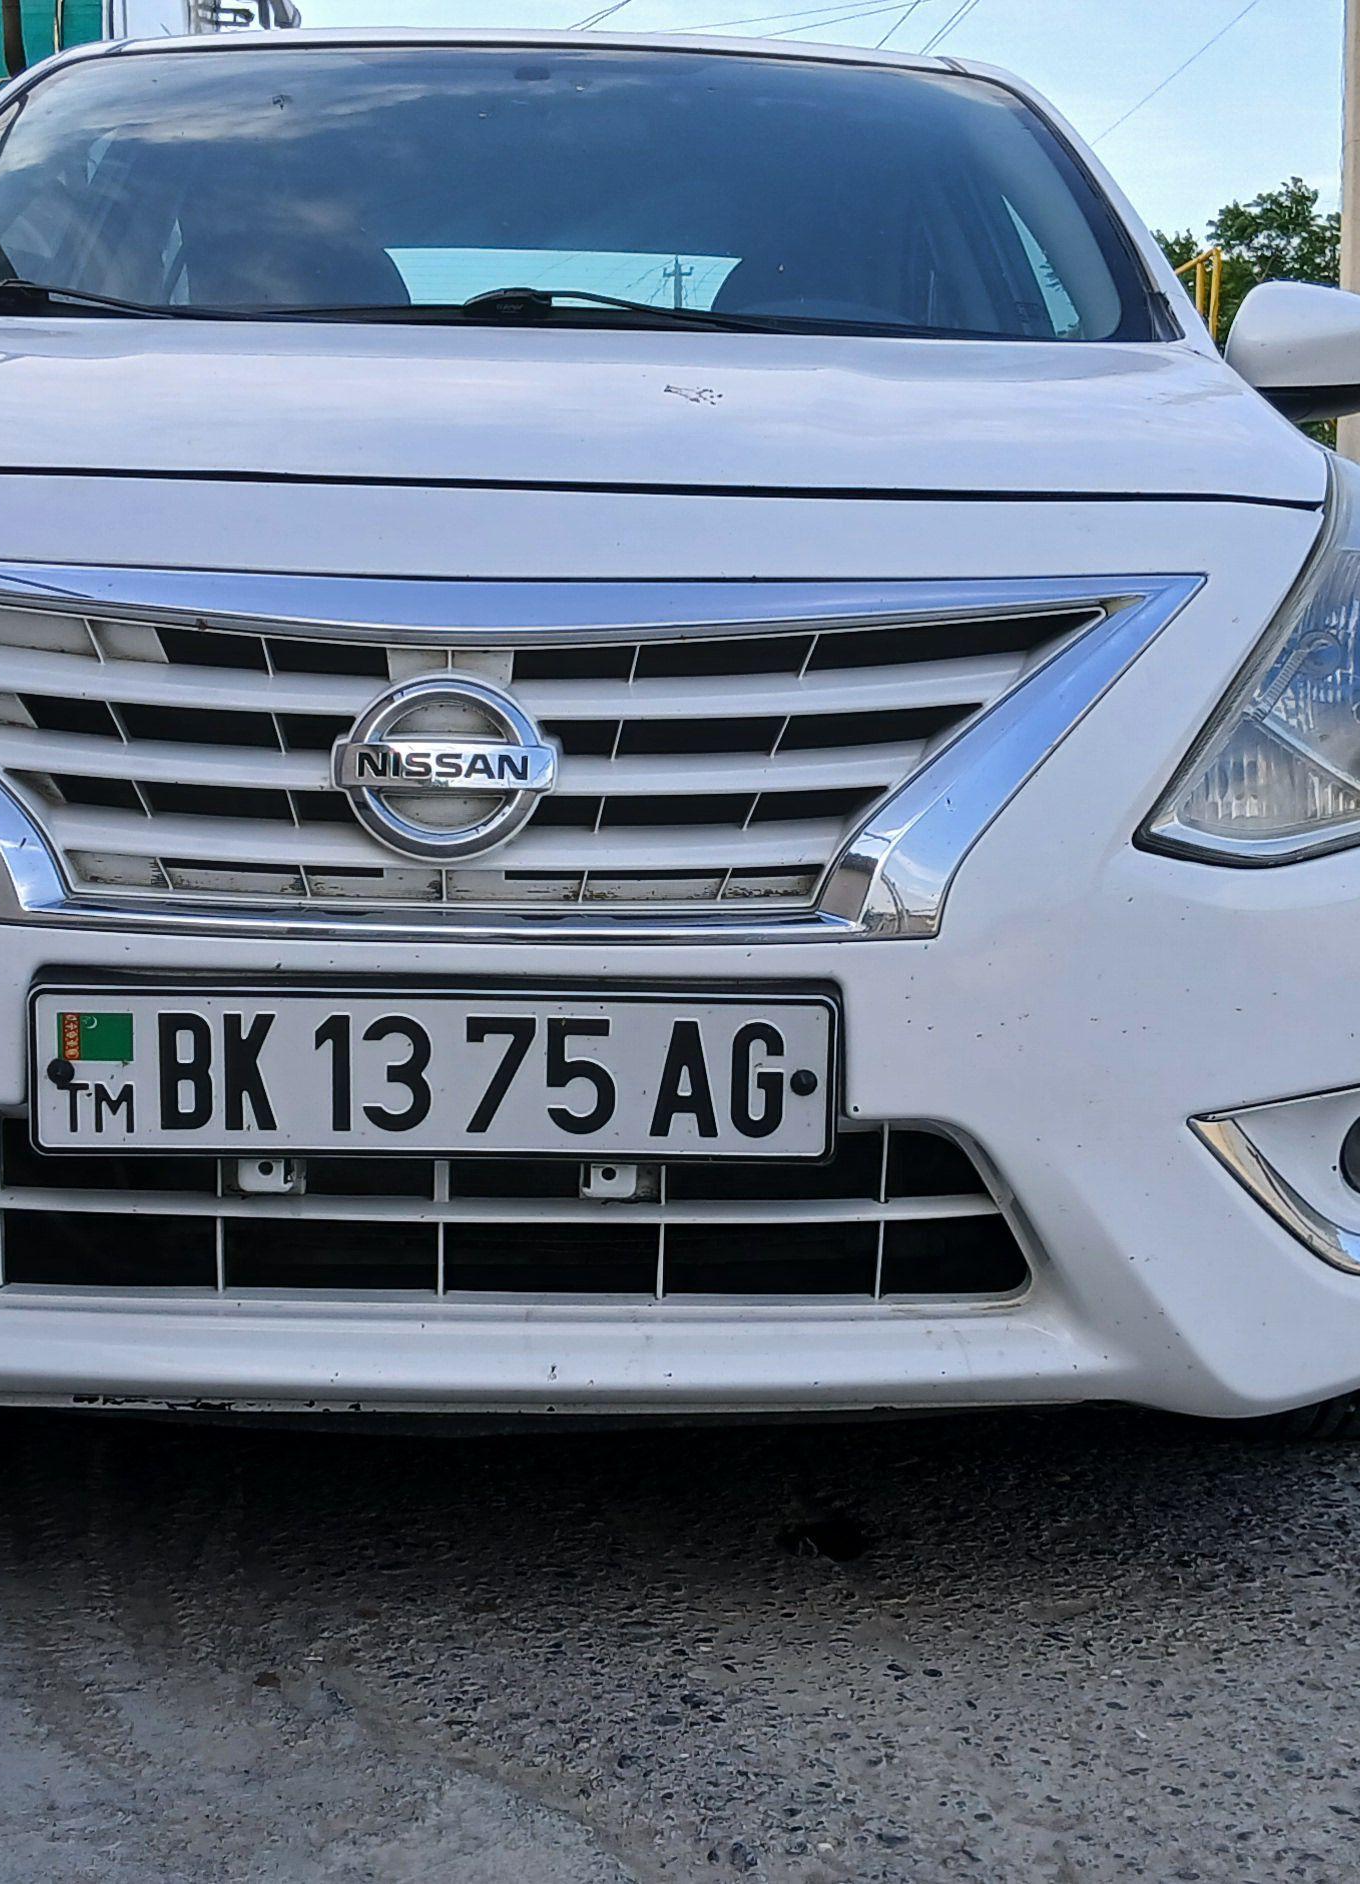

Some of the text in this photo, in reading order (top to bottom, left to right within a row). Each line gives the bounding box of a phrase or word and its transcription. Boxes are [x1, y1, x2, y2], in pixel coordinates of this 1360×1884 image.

[357, 751, 529, 781] NISSAN
[157, 1011, 278, 1132] BK
[648, 1019, 786, 1139] AG
[56, 1082, 135, 1133] TM
